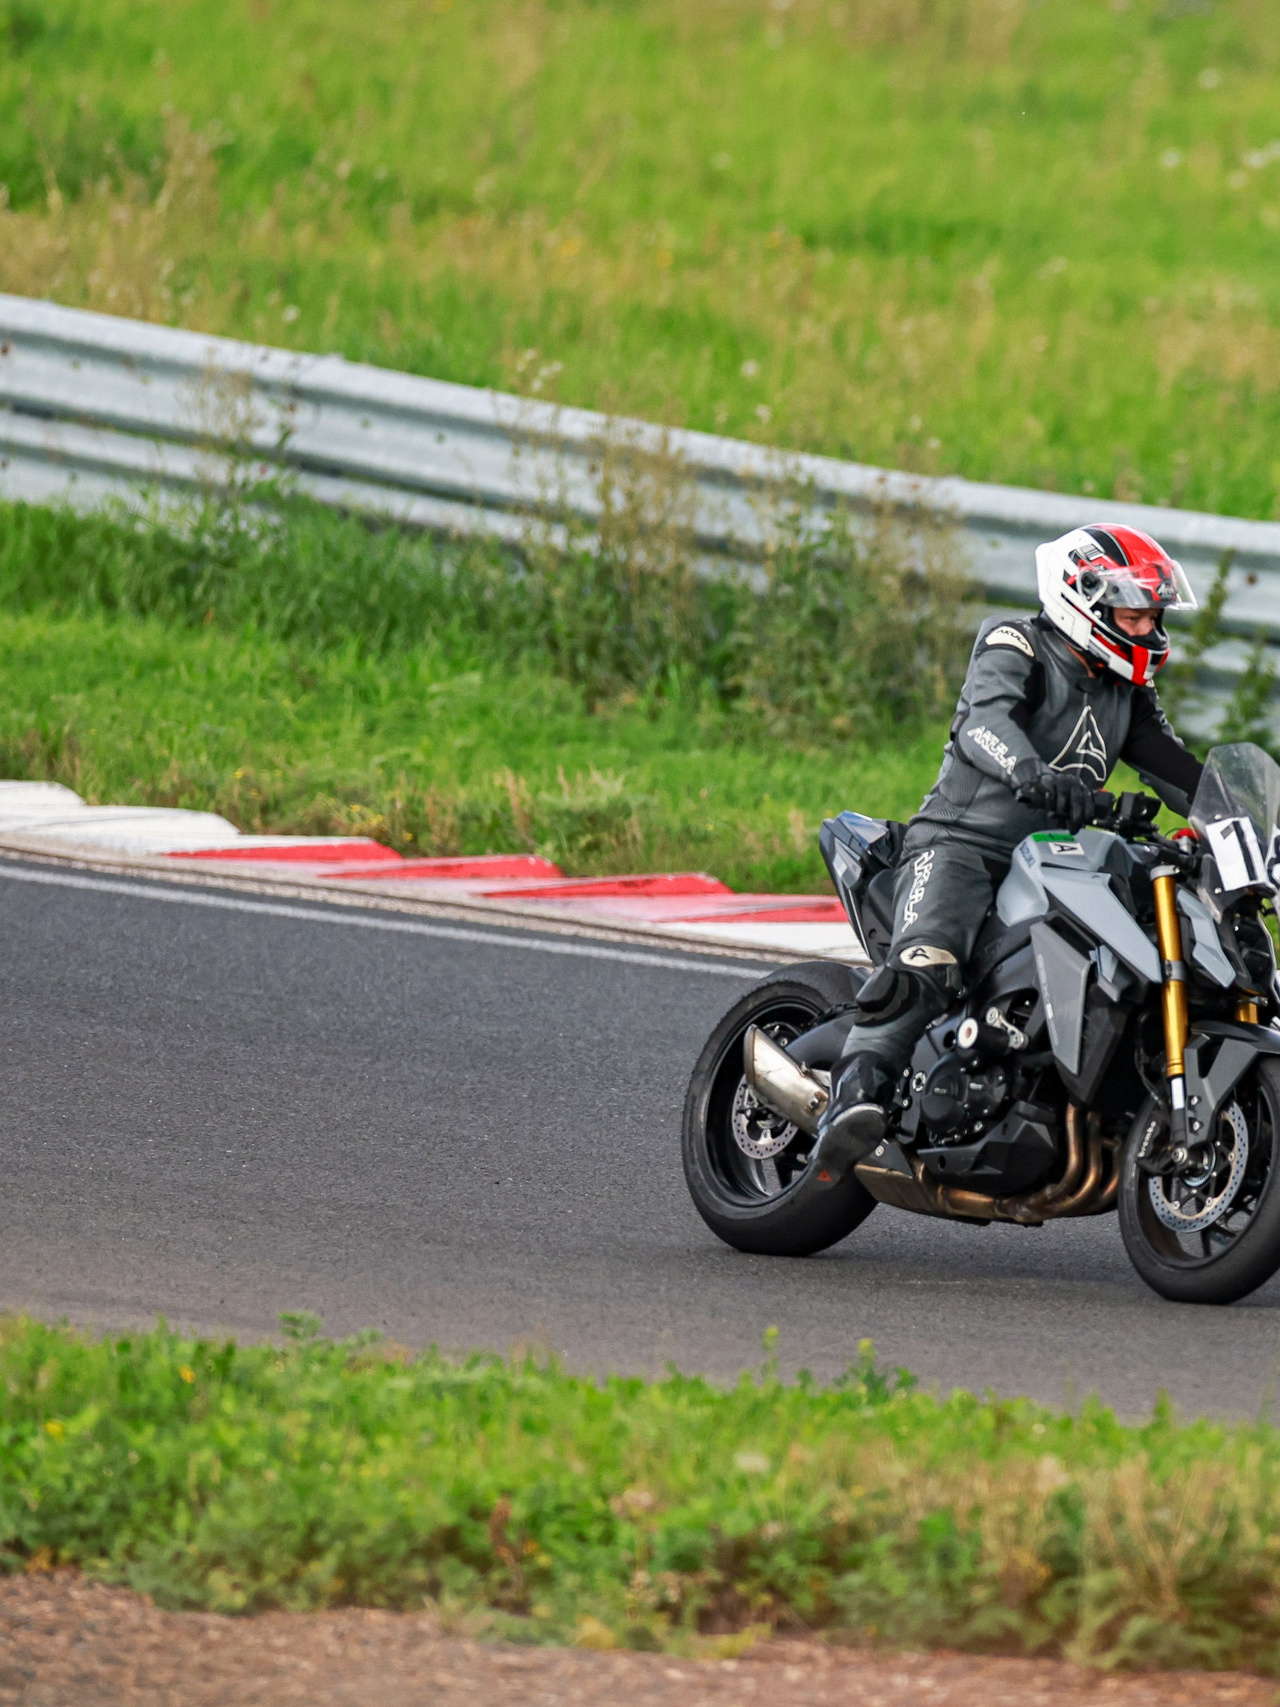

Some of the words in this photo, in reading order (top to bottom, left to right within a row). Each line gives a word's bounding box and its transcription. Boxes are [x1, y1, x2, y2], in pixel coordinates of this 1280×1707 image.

[996, 629, 1029, 650] AKULA
[967, 725, 1018, 776] AKULA
[901, 849, 935, 933] AKULA
